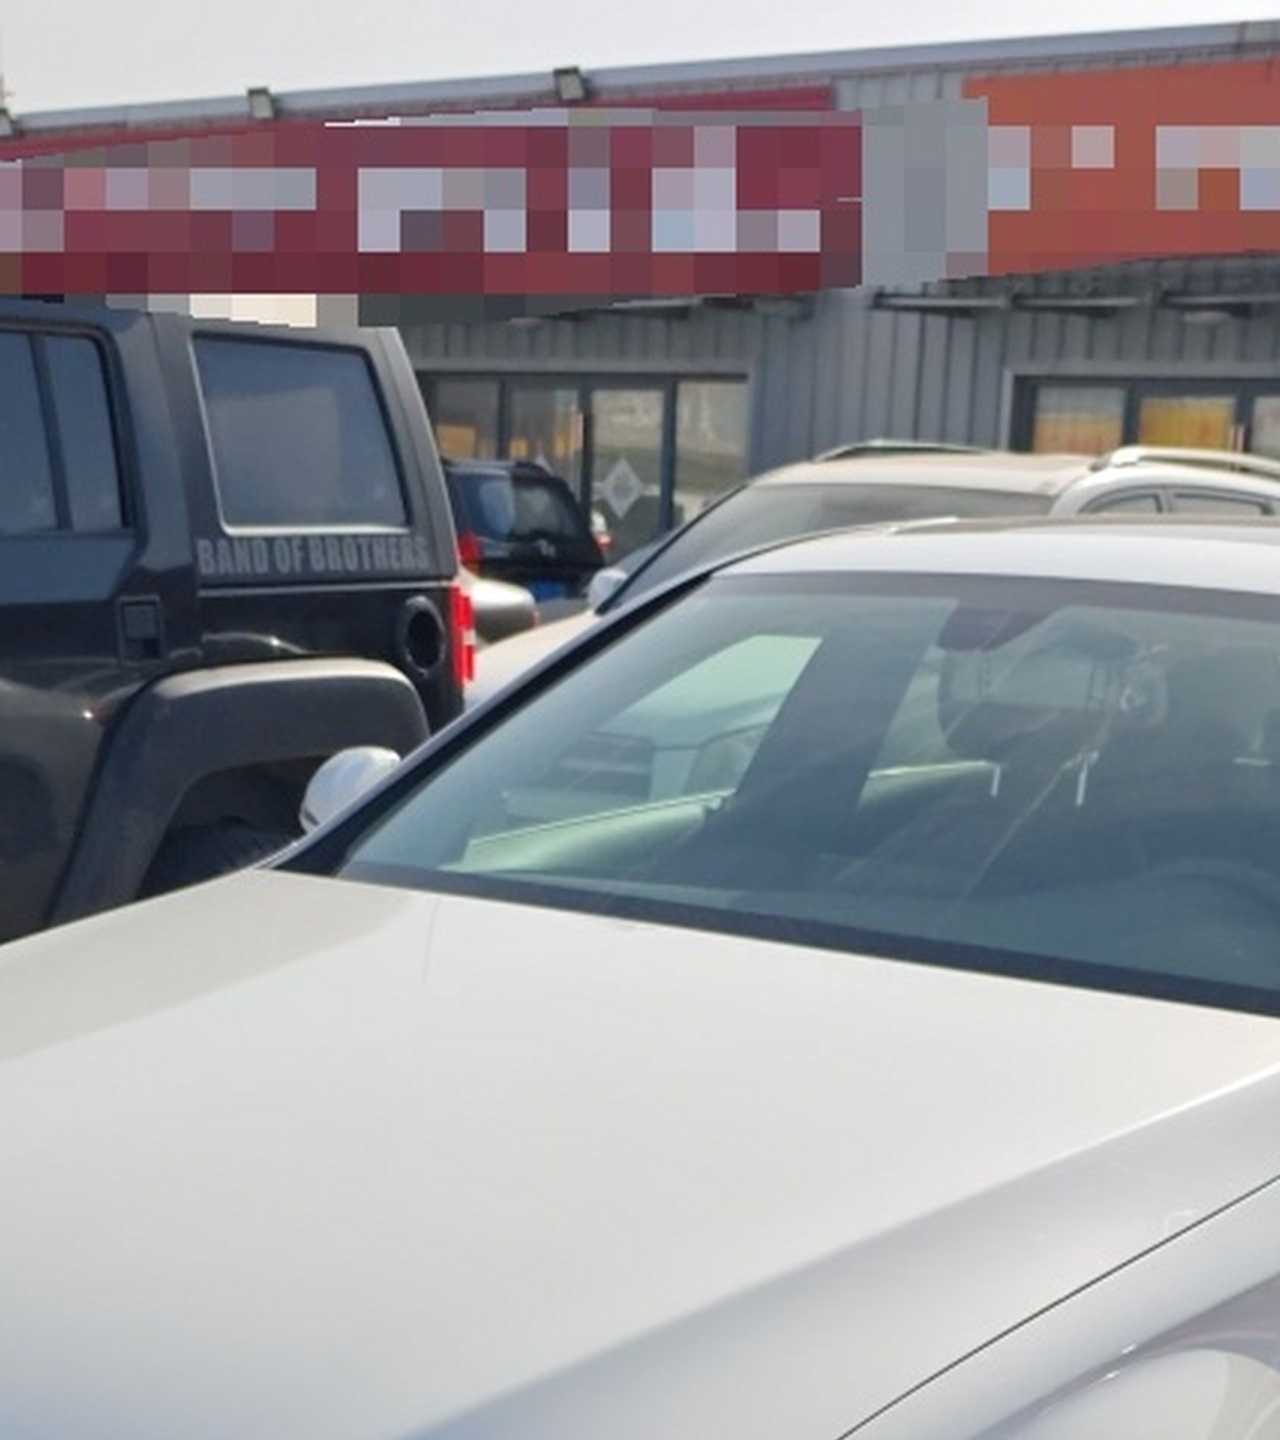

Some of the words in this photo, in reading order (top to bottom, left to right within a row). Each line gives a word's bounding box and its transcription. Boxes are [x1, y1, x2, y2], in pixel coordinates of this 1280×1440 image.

[196, 538, 270, 575] BAND
[273, 537, 304, 573] OF
[308, 536, 430, 573] BROTHERS
